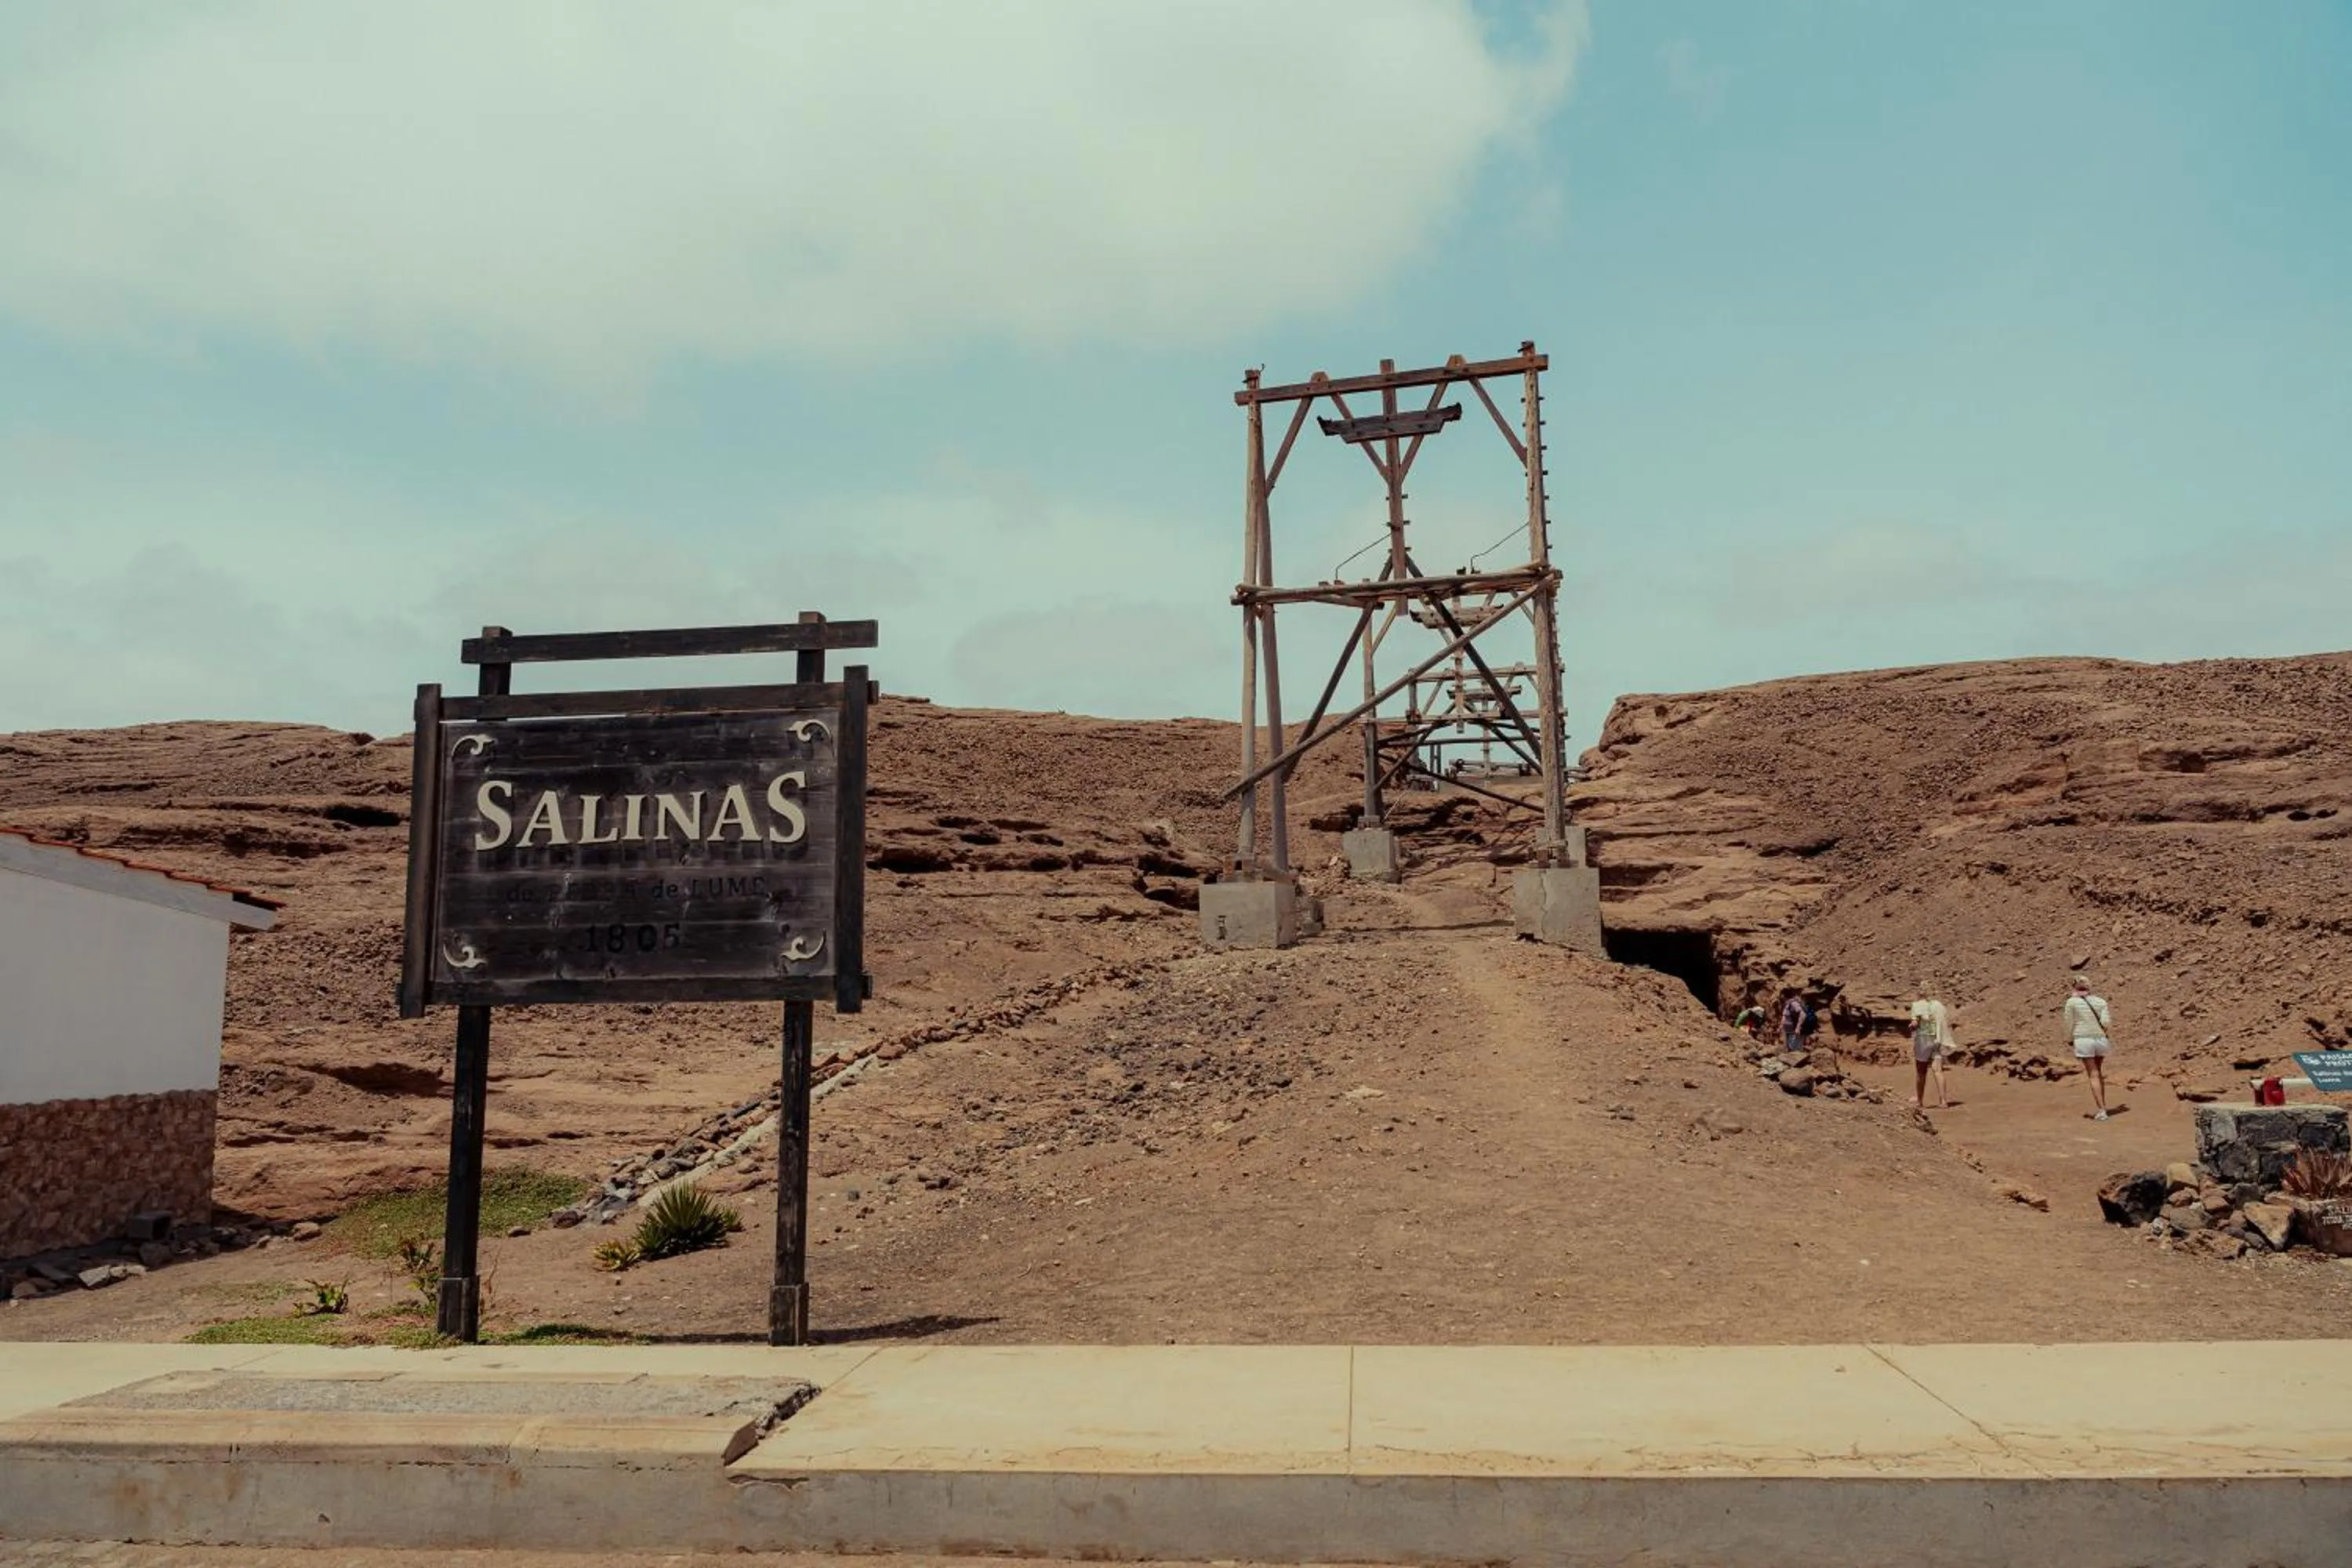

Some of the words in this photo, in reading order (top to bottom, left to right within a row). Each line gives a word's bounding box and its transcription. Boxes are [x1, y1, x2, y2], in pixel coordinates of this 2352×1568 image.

[475, 771, 808, 851] SALINAS
[652, 878, 679, 899] de
[690, 876, 767, 900] LUME
[583, 922, 681, 953] 1805
